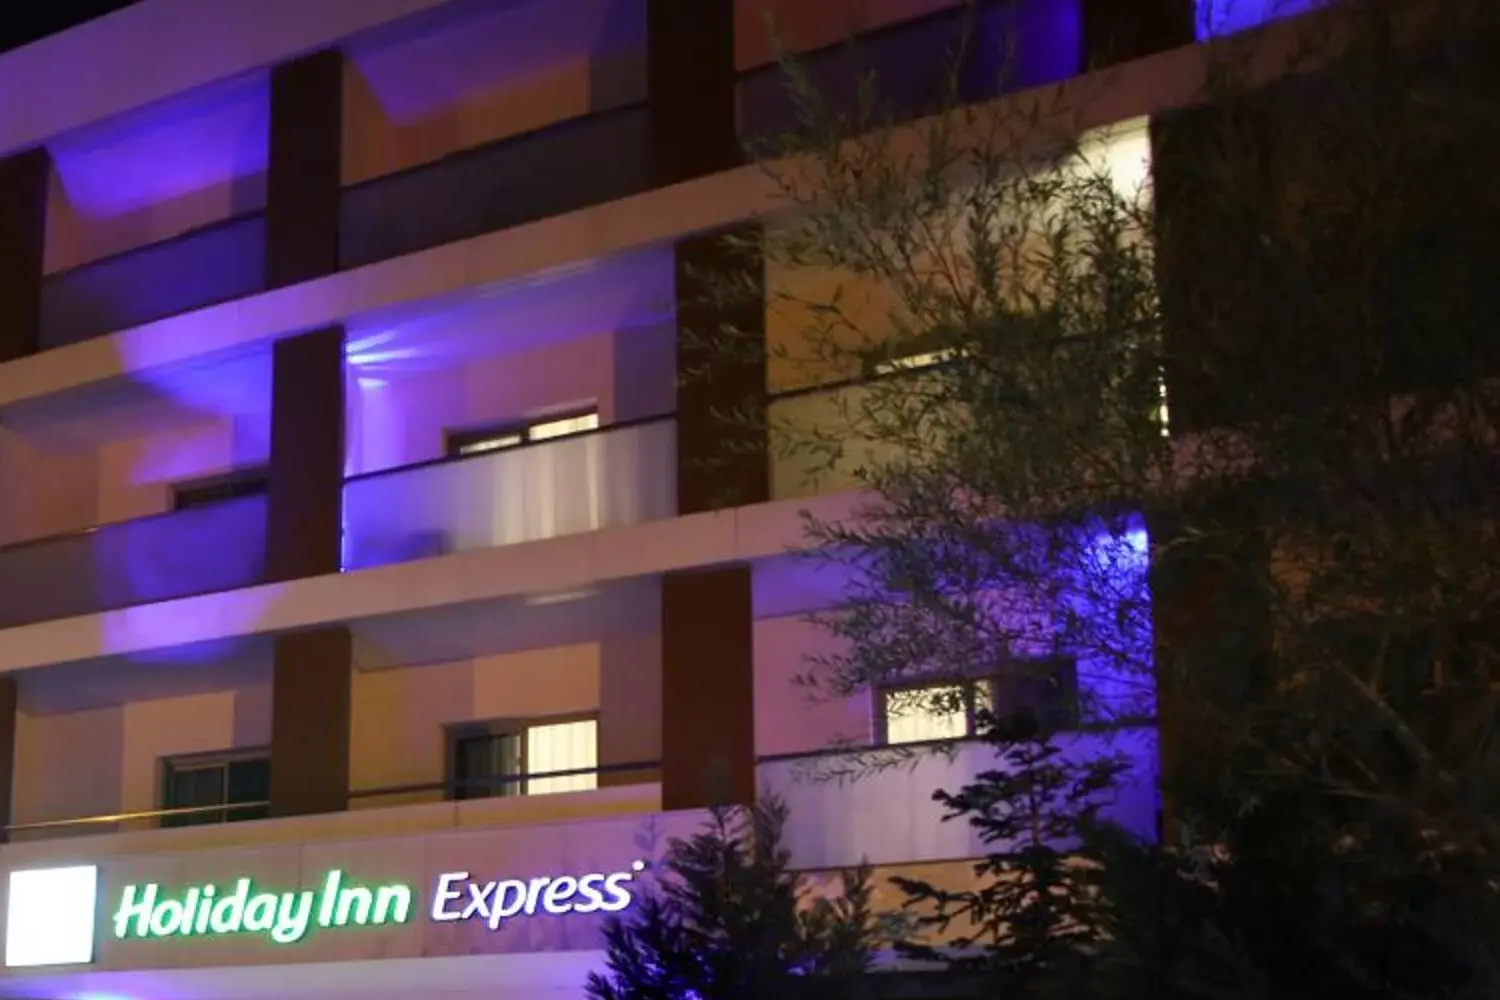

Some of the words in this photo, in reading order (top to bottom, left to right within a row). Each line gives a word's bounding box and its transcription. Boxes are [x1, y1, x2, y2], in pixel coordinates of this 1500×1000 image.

[113, 877, 313, 943] Holiday
[318, 869, 411, 927] Inn
[431, 871, 632, 930] Express
